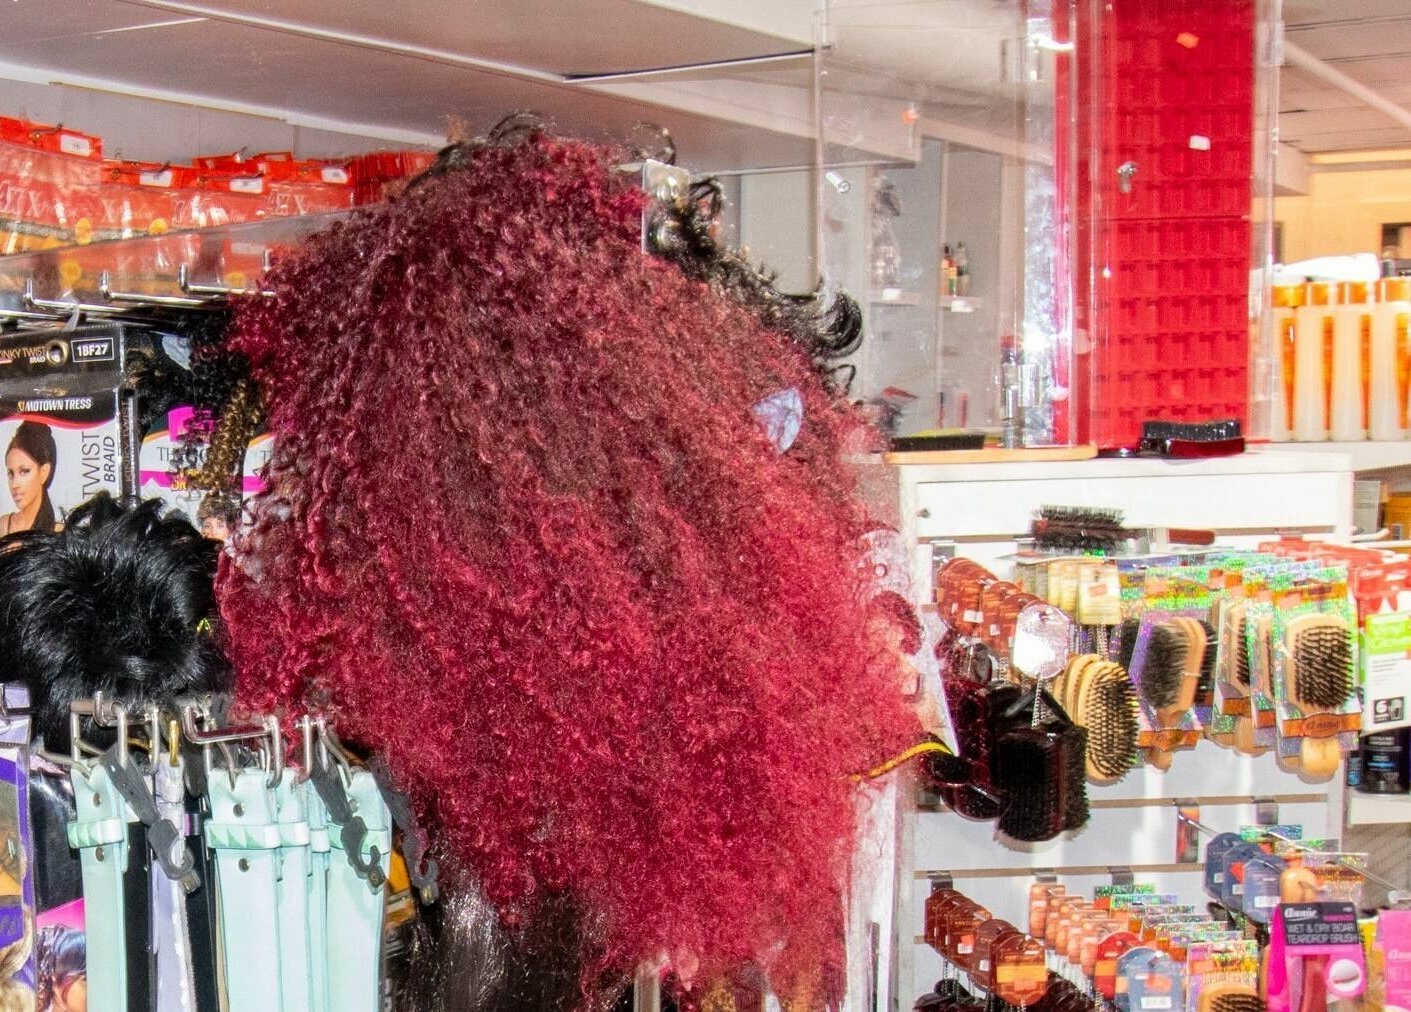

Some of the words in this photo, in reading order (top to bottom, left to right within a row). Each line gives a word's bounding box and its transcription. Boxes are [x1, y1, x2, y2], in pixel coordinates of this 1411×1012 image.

[21, 346, 46, 358] TWIST
[76, 343, 108, 357] 1BF27
[25, 399, 64, 412] MOTOWN
[64, 398, 92, 411] TRESS
[81, 431, 101, 501] TWIST
[103, 435, 116, 484] BRAID
